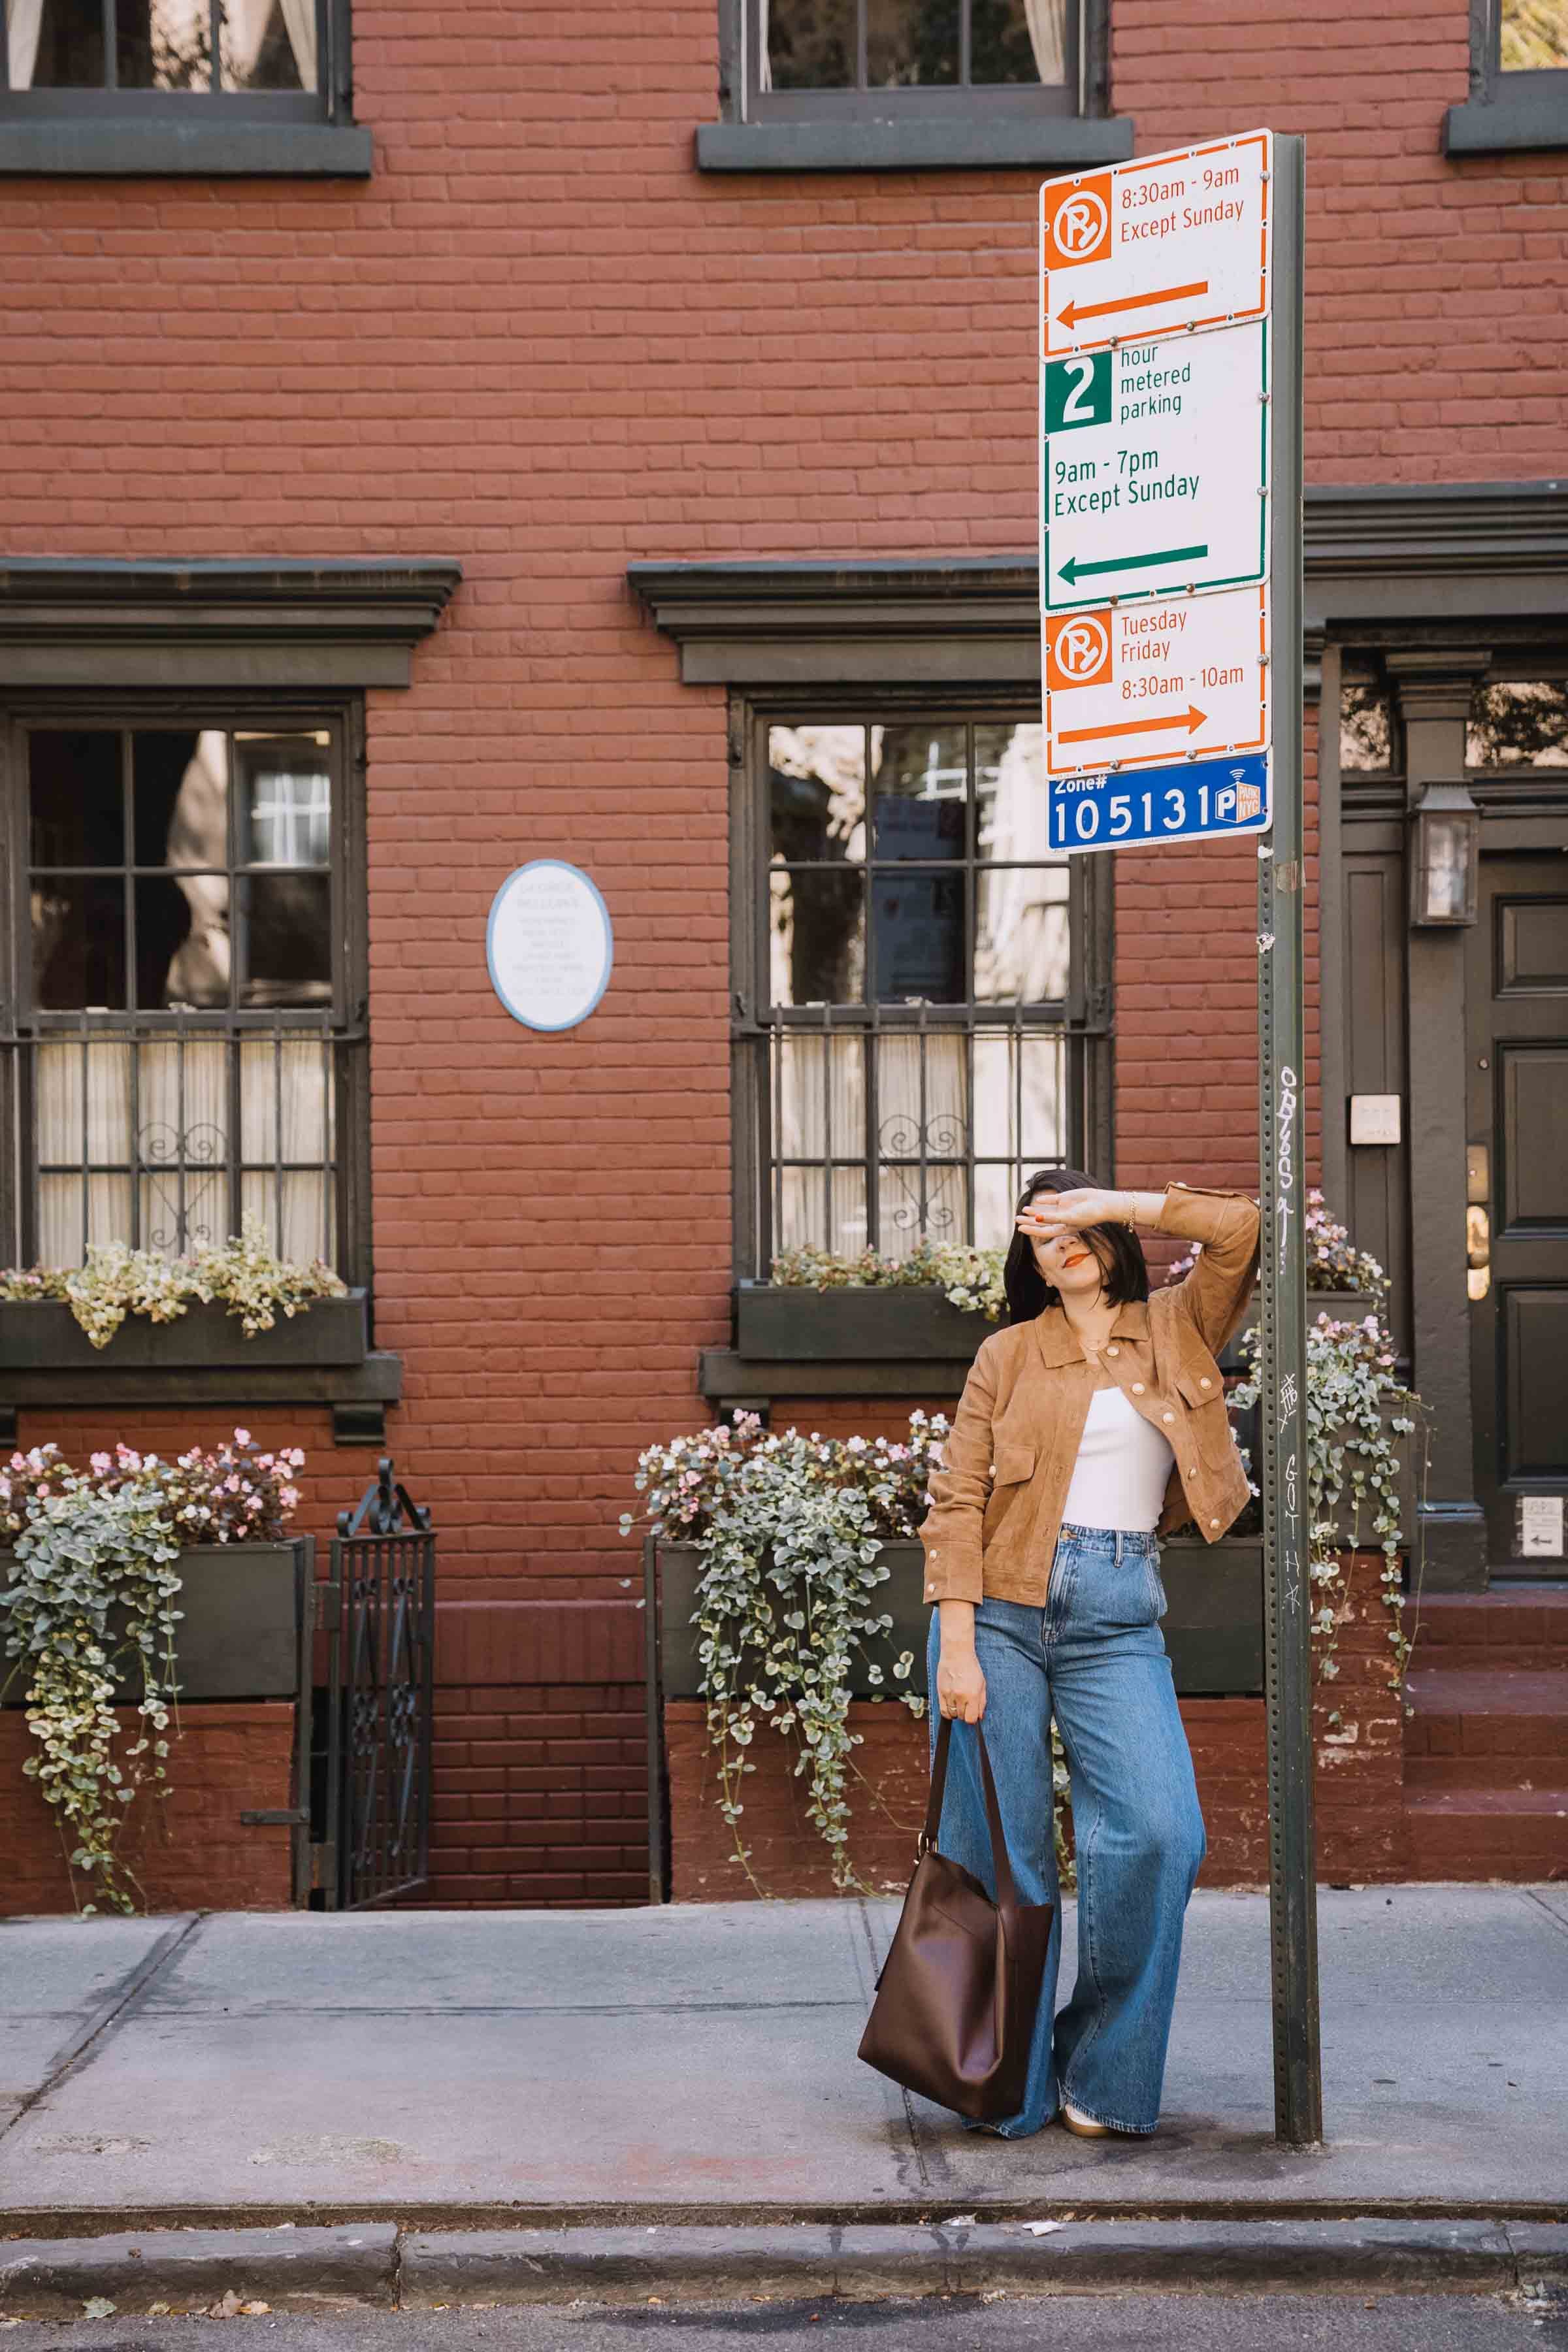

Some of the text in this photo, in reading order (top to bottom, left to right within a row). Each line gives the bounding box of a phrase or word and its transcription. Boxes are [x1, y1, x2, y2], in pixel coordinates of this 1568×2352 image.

[1122, 177, 1185, 209] 8:30am
[1203, 167, 1239, 191] 9am
[1121, 200, 1245, 242] Except Sunday
[1120, 346, 1158, 368] hour
[1062, 355, 1095, 423] 2
[1120, 362, 1191, 394] metered
[1120, 394, 1182, 425] parking
[1055, 461, 1096, 485] 9am
[1117, 449, 1159, 478] 7pm
[1055, 474, 1200, 516] Except Sunday
[1122, 611, 1187, 636] Tuesday
[1121, 640, 1171, 663] Friday
[1122, 676, 1184, 700] 8:30am
[1201, 666, 1244, 688] 10am
[1054, 774, 1109, 794] Zone#
[1055, 785, 1209, 842] 105131
